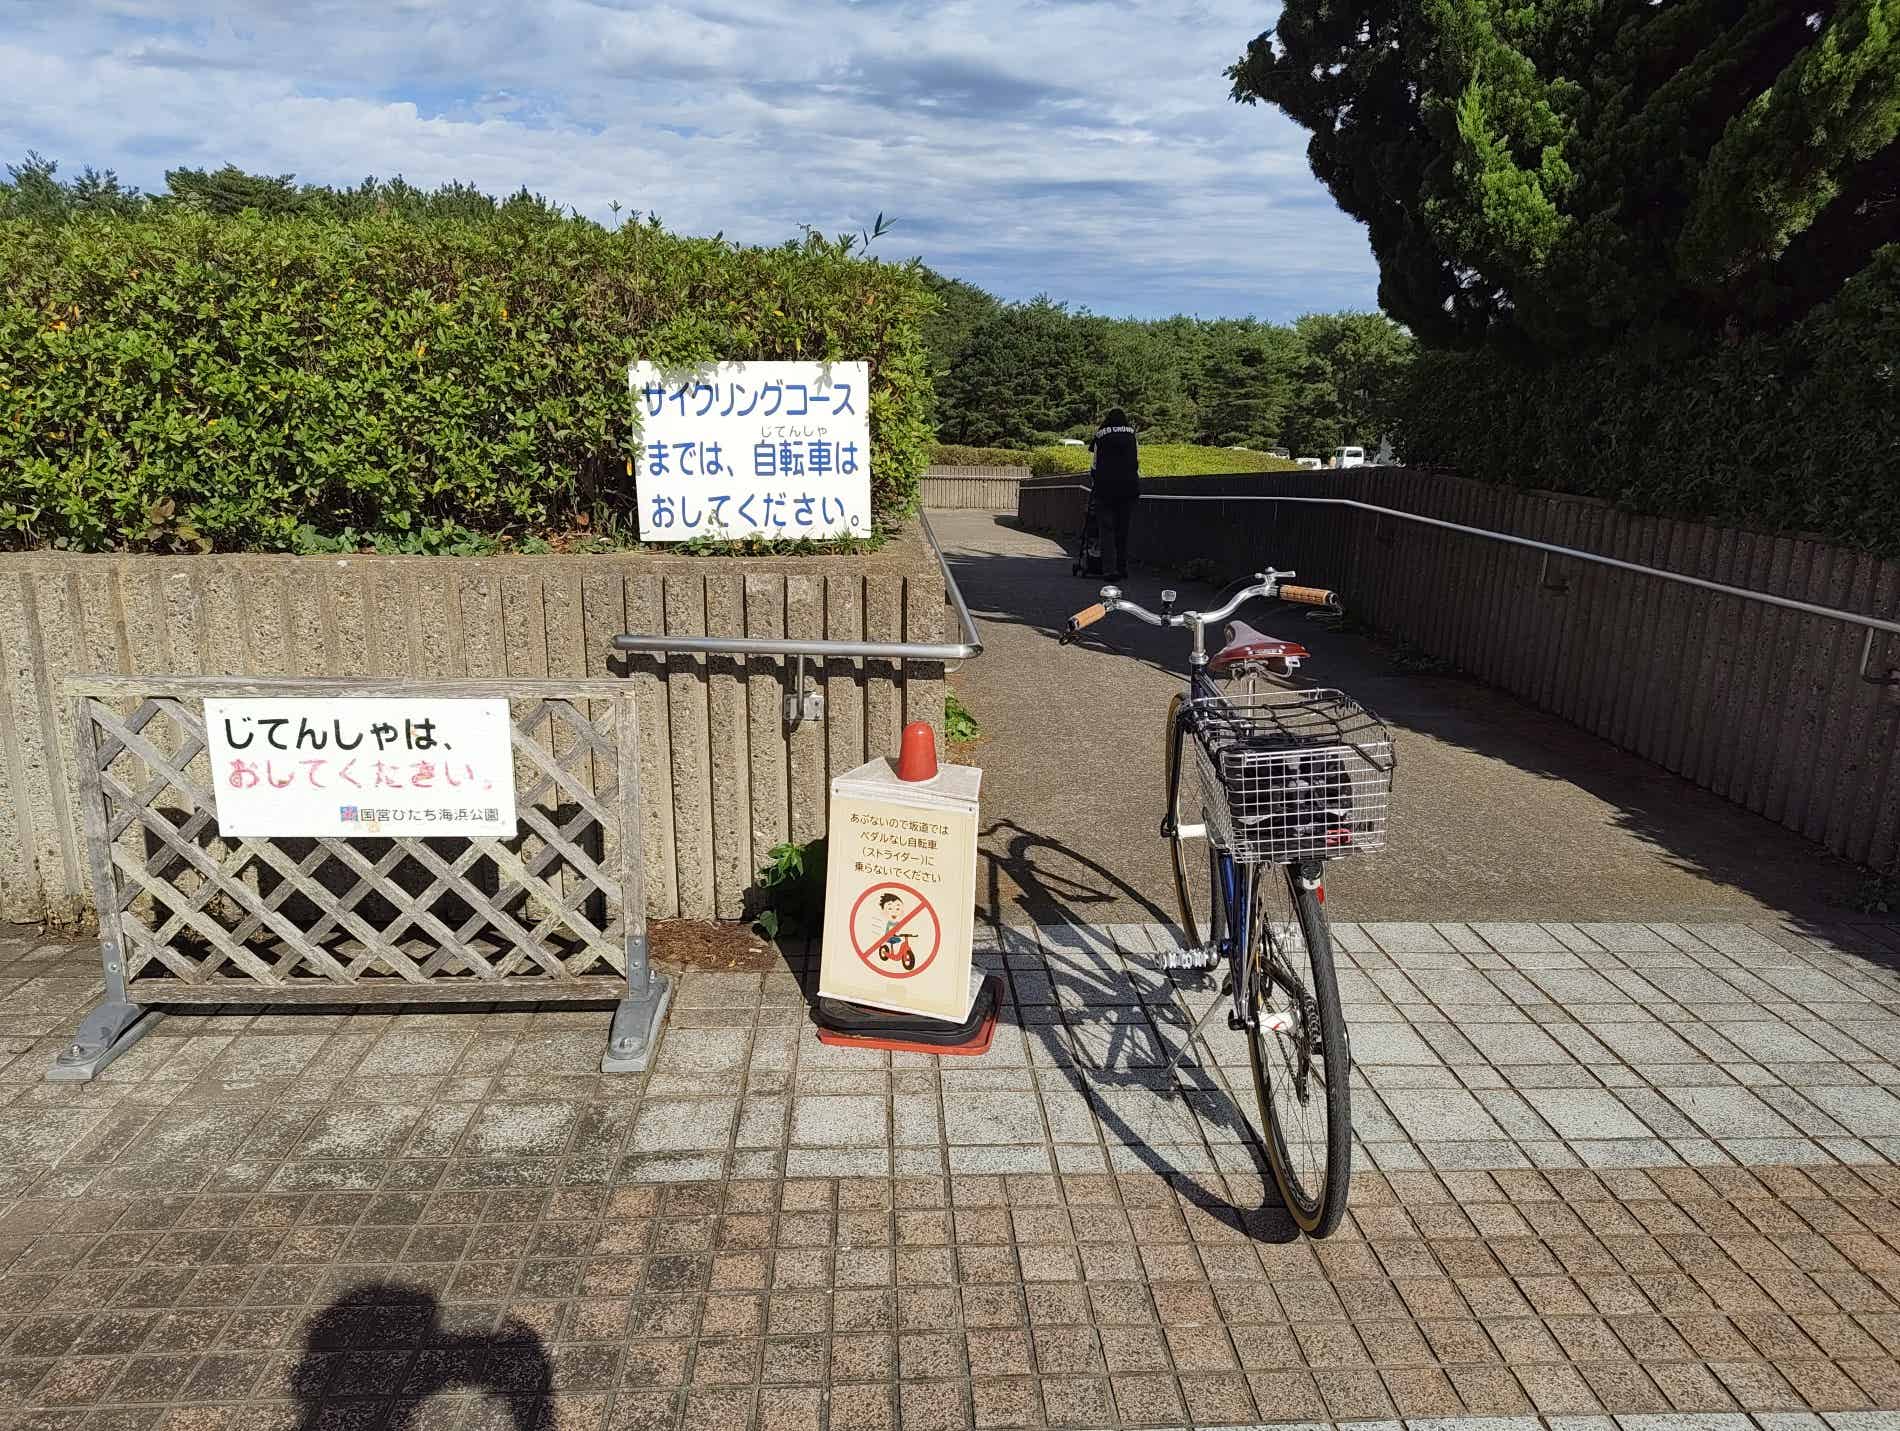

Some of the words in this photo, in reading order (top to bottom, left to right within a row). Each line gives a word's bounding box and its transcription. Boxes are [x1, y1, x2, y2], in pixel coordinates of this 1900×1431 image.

[642, 379, 855, 417] サイクリングコース
[761, 425, 828, 438] じてんしゃ
[647, 440, 859, 477] までは、自転車は
[651, 492, 860, 528] おしてください。
[225, 717, 453, 751] じてんしゃは、
[360, 808, 499, 822] 国営ひたち海浜公園
[849, 813, 949, 835] あぶないので坂道では
[854, 861, 942, 883] 乗らないでください
